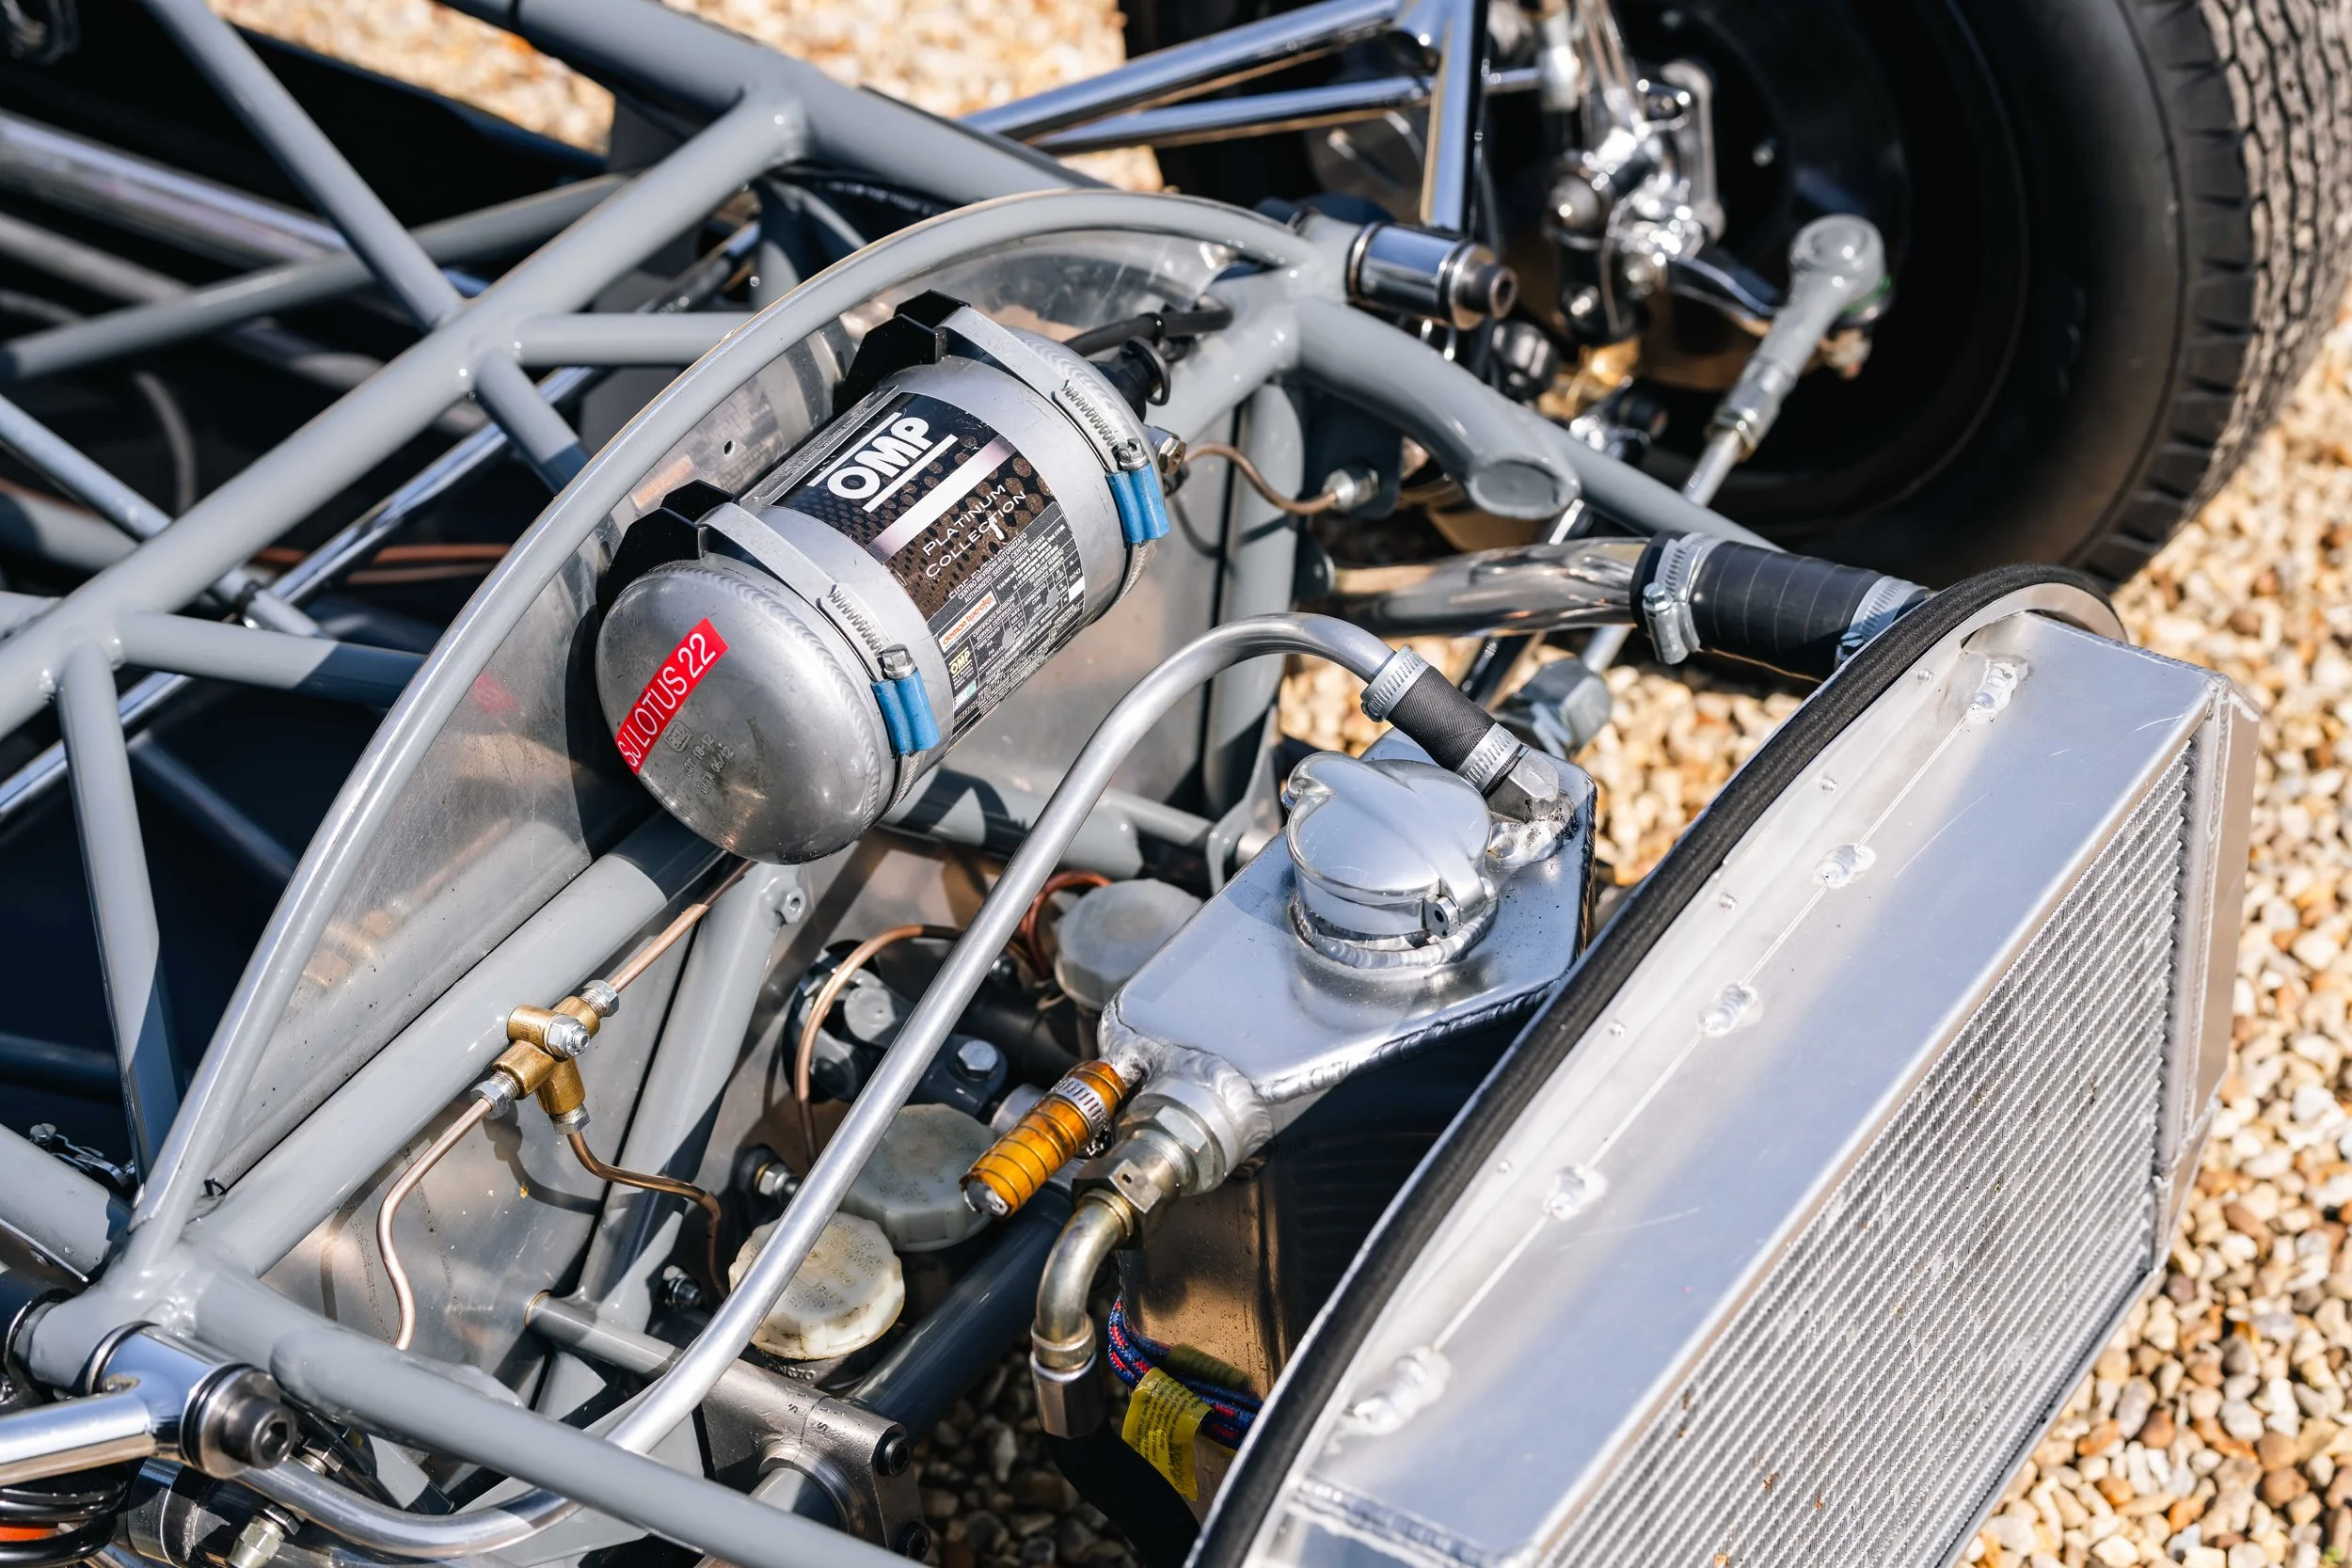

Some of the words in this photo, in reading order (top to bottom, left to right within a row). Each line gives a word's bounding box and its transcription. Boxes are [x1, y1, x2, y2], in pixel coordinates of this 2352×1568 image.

[827, 417, 933, 499] OMP
[922, 483, 1007, 556] PLATINUM
[926, 490, 1027, 578] COLLECTION
[957, 579, 977, 600] CENTRO
[976, 559, 997, 582] REVISIONI
[996, 531, 1026, 562] AUTORIZZATO
[964, 574, 993, 603] AUTHORIZED
[992, 555, 1011, 577] SERVICE
[1010, 539, 1029, 559] CENTRE
[943, 619, 966, 645] demon
[965, 594, 993, 622] tweeks
[976, 624, 993, 641] SERVICE
[677, 632, 716, 679] 22
[949, 649, 971, 674] OMP
[627, 666, 688, 748] LOTUS
[617, 731, 643, 767] SJ
